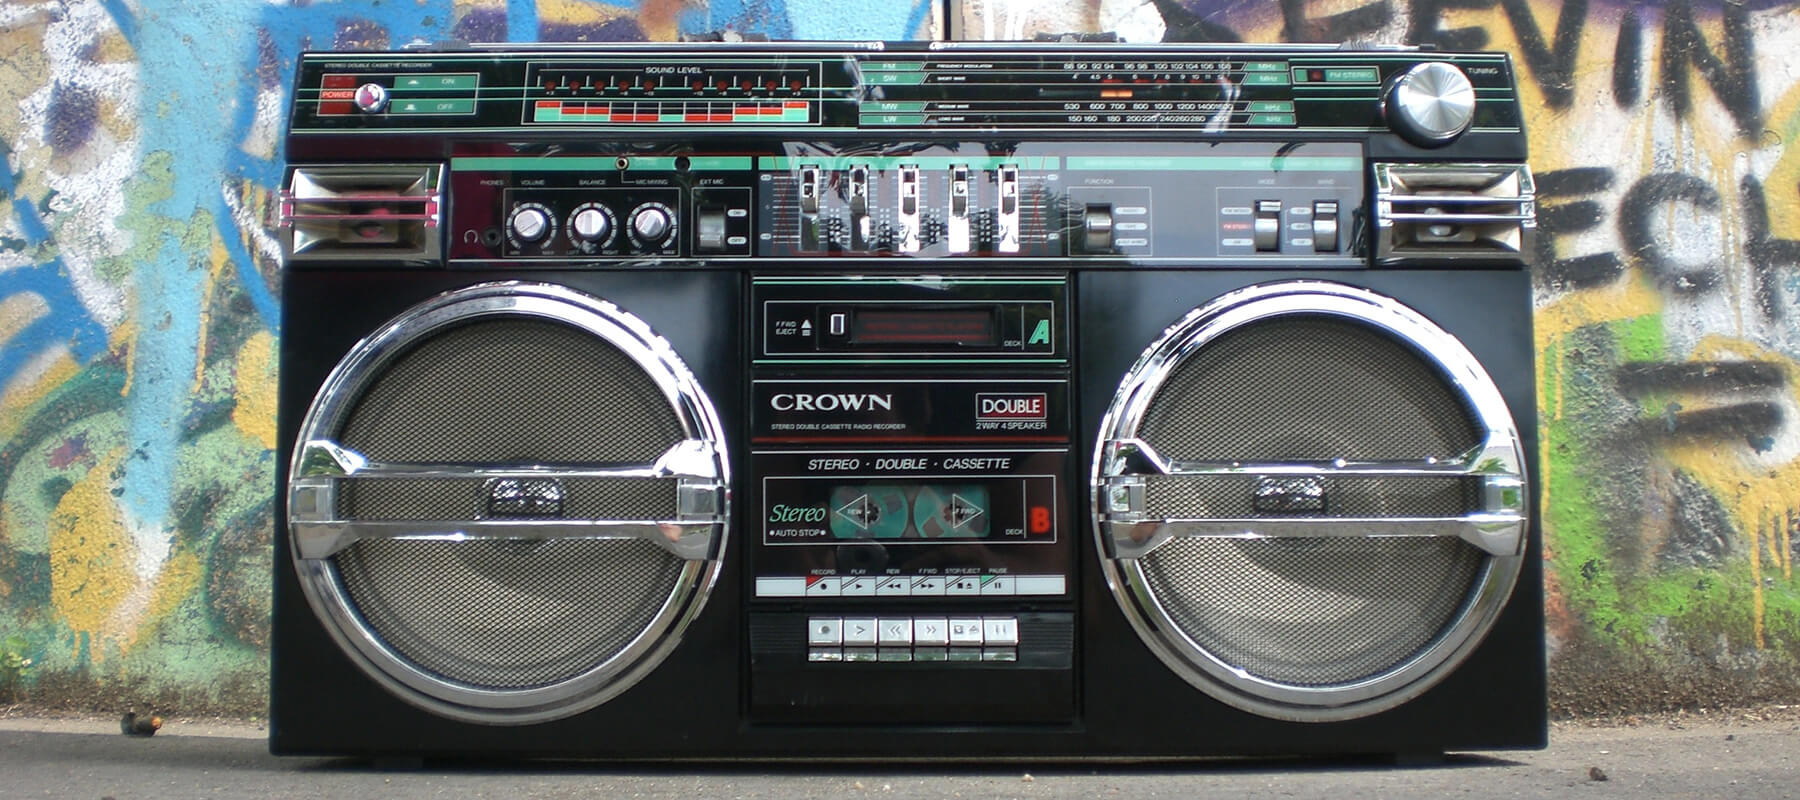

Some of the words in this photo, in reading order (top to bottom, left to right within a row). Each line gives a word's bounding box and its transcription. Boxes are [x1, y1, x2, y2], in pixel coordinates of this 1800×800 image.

[645, 66, 675, 74] SOUND
[676, 66, 703, 74] LEVEL
[882, 74, 897, 82] SW
[1028, 319, 1050, 344] A
[770, 393, 892, 411] CROWN
[982, 398, 1041, 413] DOUBLE
[807, 458, 860, 470] STEREO
[875, 458, 928, 470] DOUBLE
[943, 457, 1011, 469] CASSETTE
[769, 504, 826, 522] Stereo
[1031, 506, 1050, 533] B
